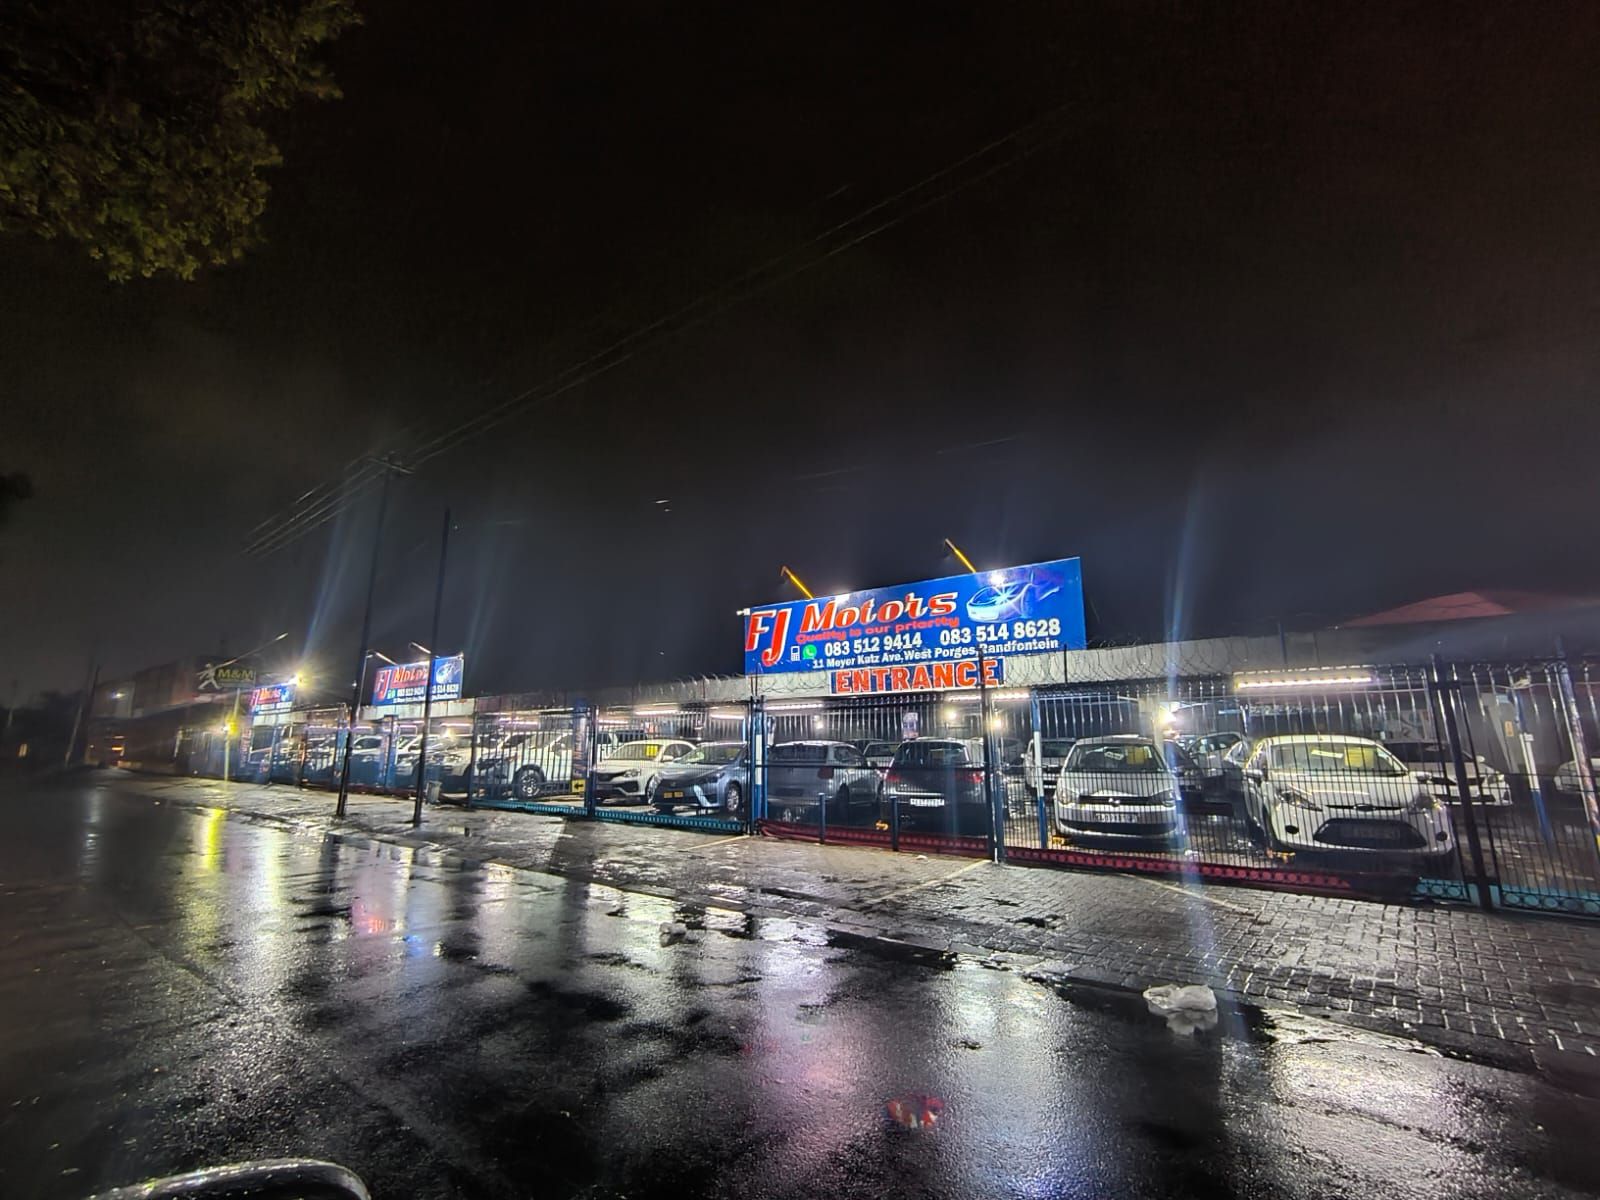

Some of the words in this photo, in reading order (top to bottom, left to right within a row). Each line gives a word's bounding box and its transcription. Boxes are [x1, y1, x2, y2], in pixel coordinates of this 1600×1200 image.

[745, 608, 792, 667] FJ
[800, 592, 958, 633] Motors
[825, 640, 850, 657] 083
[853, 636, 881, 653] 512
[883, 631, 923, 651] 9414
[940, 627, 972, 646] 083
[976, 623, 1009, 642] 514
[1013, 618, 1061, 639] 8628
[865, 624, 890, 635] our
[895, 617, 960, 634] priority
[812, 659, 825, 669] 11
[826, 657, 856, 669] Meyer
[858, 653, 880, 665] Katz
[218, 669, 254, 679] M&M
[836, 661, 999, 693] ENTRANCE
